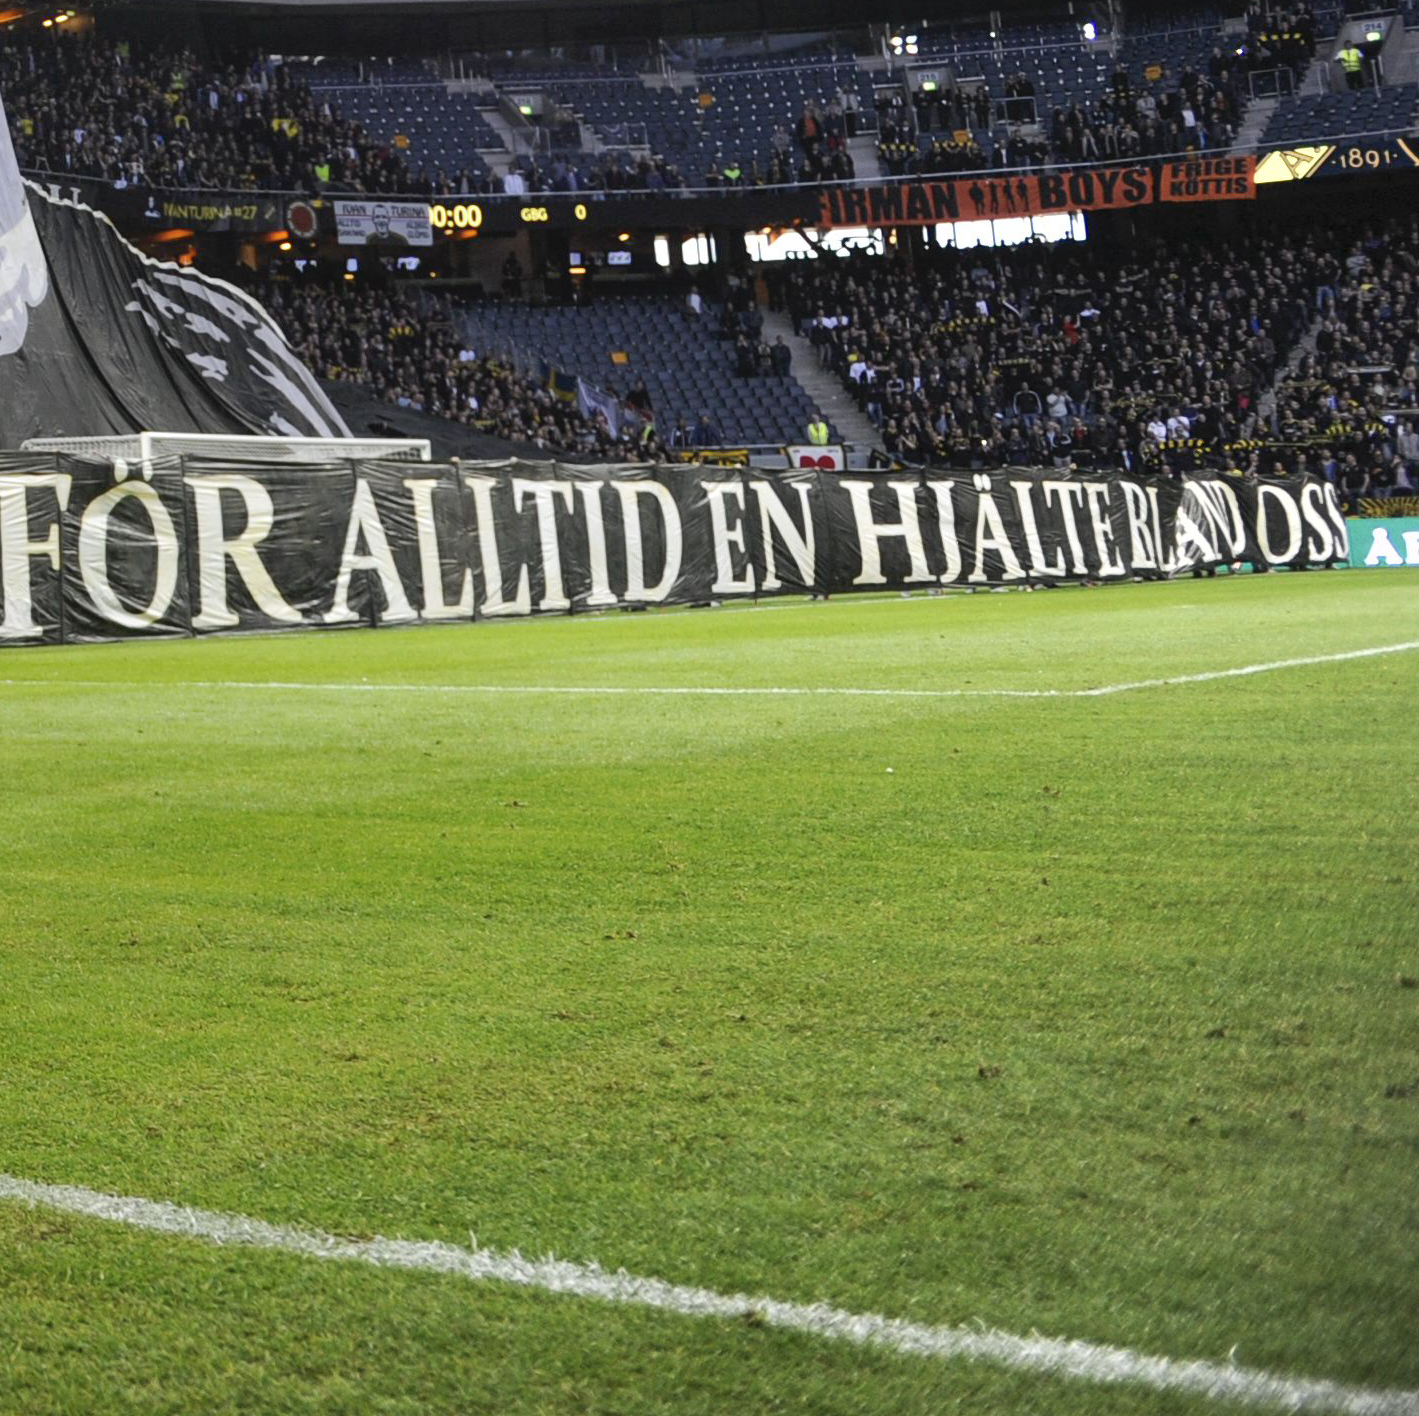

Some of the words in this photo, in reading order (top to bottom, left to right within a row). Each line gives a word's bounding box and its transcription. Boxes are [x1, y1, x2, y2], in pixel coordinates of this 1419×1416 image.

[1171, 158, 1248, 178] FRIGE
[1038, 168, 1148, 209] BOYS
[520, 207, 548, 222] GBG
[575, 204, 587, 221] 0
[323, 475, 684, 622] ALLTID
[702, 480, 817, 594] EN
[839, 474, 1126, 586] HJÄLTE
[1257, 483, 1349, 564] OSS
